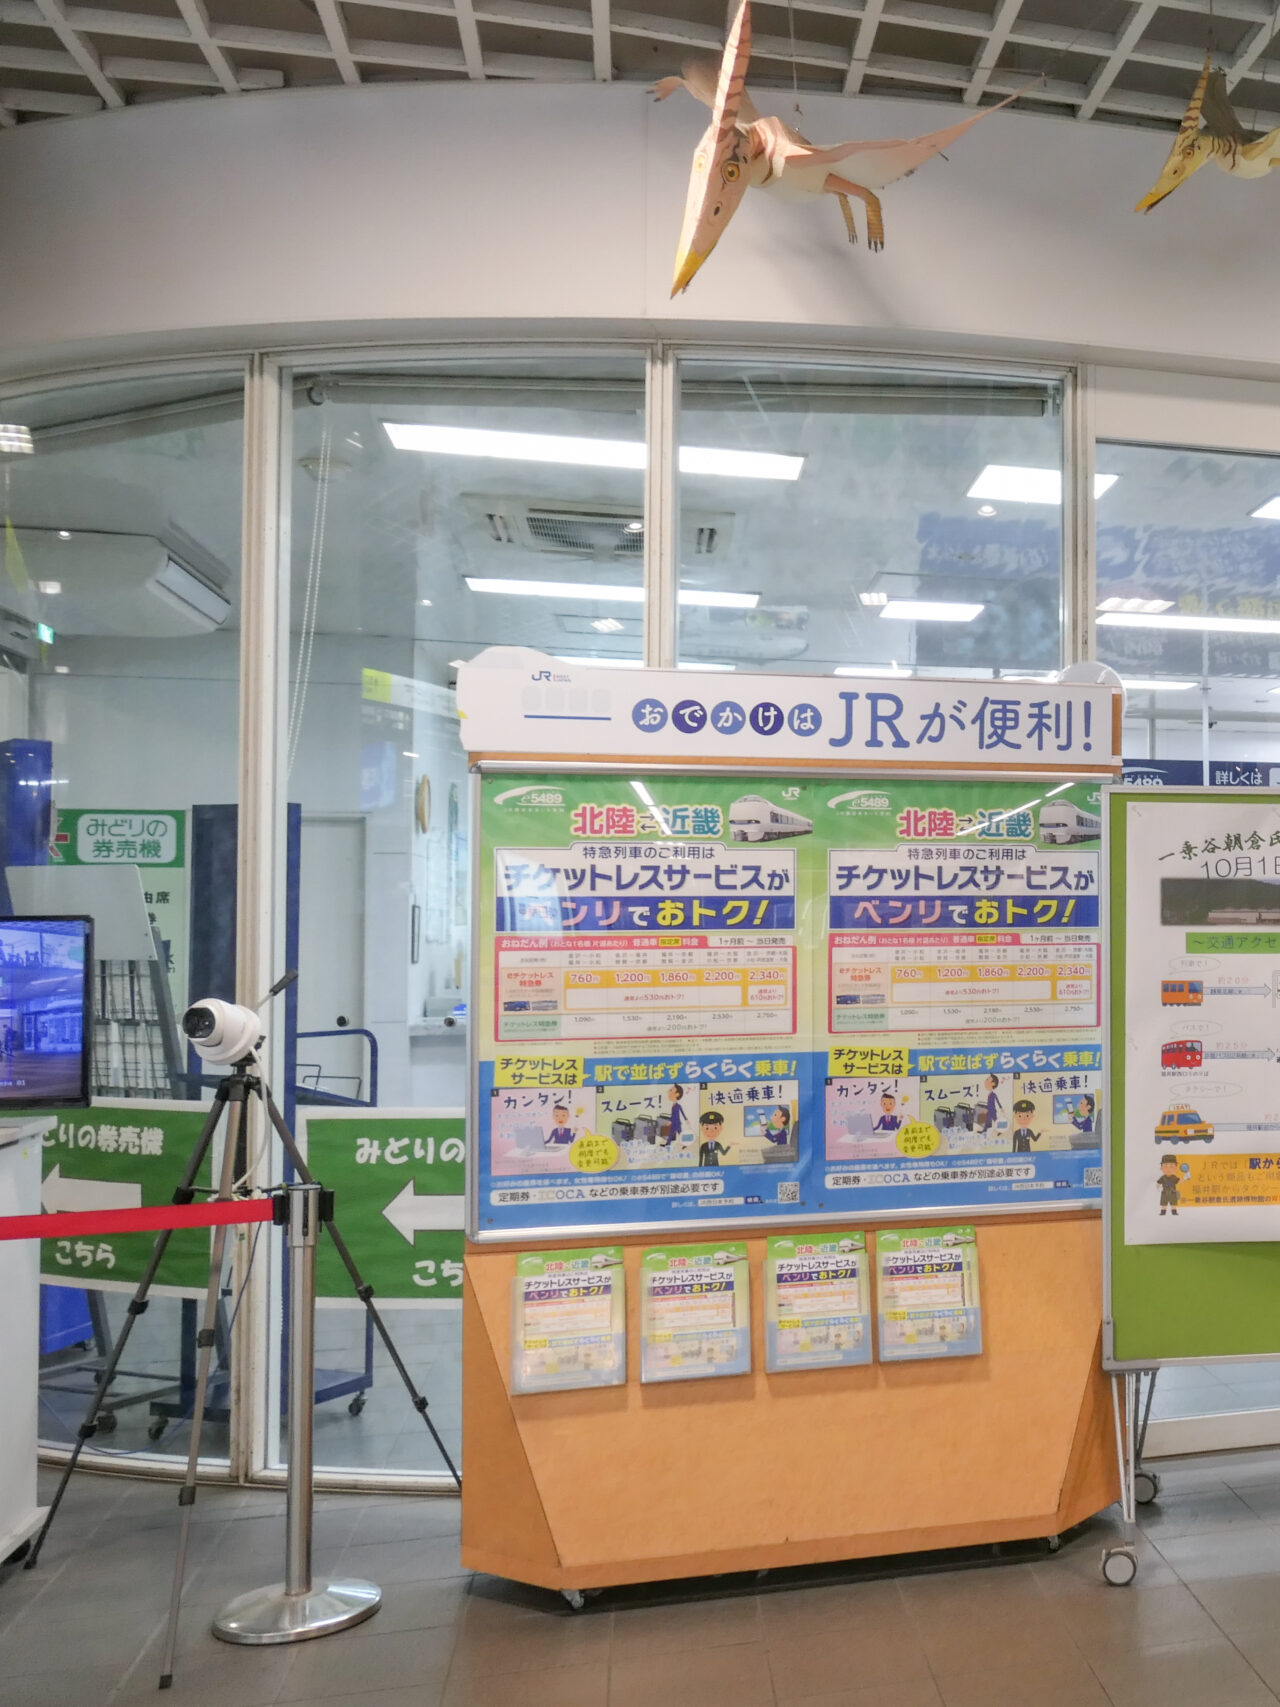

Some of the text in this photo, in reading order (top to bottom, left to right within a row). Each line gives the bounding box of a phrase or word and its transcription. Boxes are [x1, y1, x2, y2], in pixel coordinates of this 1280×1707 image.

[640, 690, 1093, 752] おでかけは JRが便利!
[1215, 770, 1262, 785] 詳しくは
[86, 818, 168, 837] みどりの
[573, 805, 722, 836] 北陸 近畿
[898, 809, 1032, 838] 北陸 近畿
[92, 839, 162, 859] 券売機
[582, 845, 715, 861] 特急列車のご利用は
[907, 846, 1027, 861] 特急列車のご利用は
[503, 864, 790, 893] チケットレスサービスが
[836, 866, 1094, 893] チケットレスサービスが
[854, 899, 1077, 926] ベンリでおトク!
[500, 1058, 577, 1071] チケットレス
[833, 1050, 903, 1062] チケットレス
[918, 1050, 1101, 1071] 駅で並ばずらくらく乗車!
[594, 1059, 797, 1081] 駅で並ばずらくらく乗車!
[843, 1062, 903, 1075] サービスは
[512, 1072, 577, 1085] サービスは
[836, 1079, 898, 1097] カンタン!
[1023, 1074, 1088, 1093] 快適乗車!
[504, 1090, 573, 1109] カンタン!
[709, 1084, 783, 1105] 快適乗車!
[914, 1167, 1032, 1181] などの乗車券が別途必要です
[589, 1182, 719, 1197] などの乗車券が別途必要です
[55, 1241, 116, 1269] こちら
